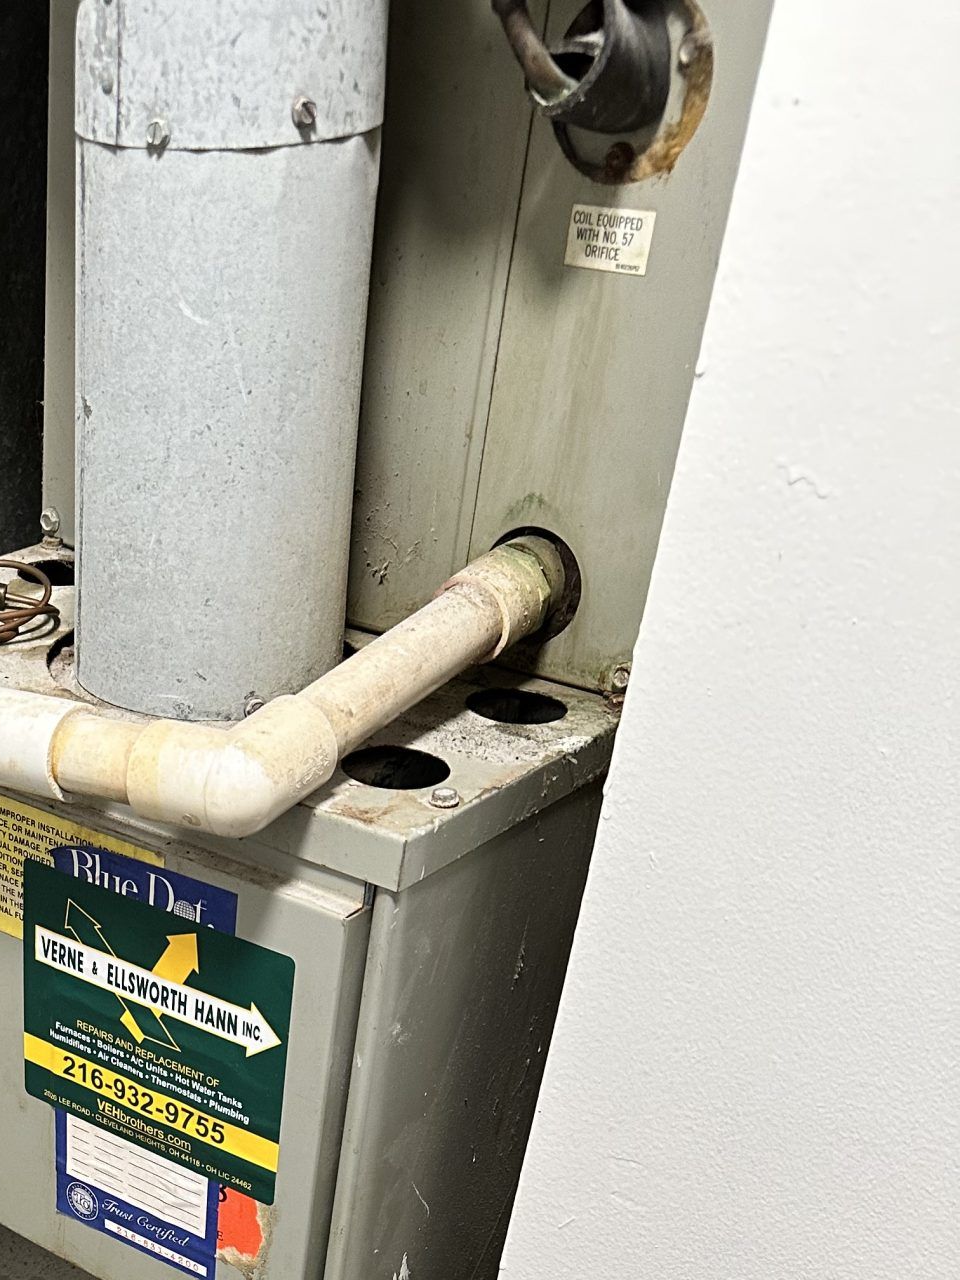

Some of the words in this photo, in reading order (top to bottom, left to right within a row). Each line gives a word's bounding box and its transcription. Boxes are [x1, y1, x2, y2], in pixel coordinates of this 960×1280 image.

[573, 210, 594, 226] COIL
[596, 213, 643, 232] EQUIPPED
[576, 226, 600, 242] WITH
[602, 230, 618, 245] NO.
[621, 232, 635, 247] 57
[584, 244, 621, 261] ORIFICE
[11, 823, 23, 834] OR
[0, 894, 8, 904] IN
[9, 898, 24, 911] THE
[1, 884, 16, 897] THE
[40, 935, 85, 974] VERNE
[91, 960, 99, 976] &
[106, 962, 188, 1017] ELLSWORTH
[194, 997, 239, 1038] HANN
[241, 1020, 263, 1043] INC.
[49, 1028, 92, 1054] Humidifiers
[97, 1050, 110, 1062] Air
[110, 1056, 144, 1079] Cleaners
[150, 1074, 202, 1104] Thermostats
[208, 1099, 250, 1126] Plumbing
[55, 1021, 91, 1043] Furnaces
[96, 1039, 125, 1058] Boilers
[130, 1055, 144, 1068] A/C
[145, 1061, 168, 1078] Units
[174, 1073, 190, 1087] Hot
[191, 1079, 216, 1098] Water
[217, 1091, 243, 1109] Tanks
[76, 1019, 114, 1043] REPAIRS
[114, 1037, 134, 1052] AND
[134, 1045, 205, 1082] REPLACEMENT
[205, 1076, 220, 1088] OF
[62, 1055, 226, 1145] 216-932-9755
[96, 1097, 192, 1151] VEHbrothers.com
[58, 1096, 72, 1107] LEE
[71, 1102, 91, 1117] ROAD
[95, 1113, 134, 1137] CLEVELAND
[168, 1147, 180, 1159] OH
[180, 1152, 201, 1168] 44118
[205, 1164, 218, 1176] OH
[217, 1170, 230, 1181] LIC
[101, 1198, 135, 1222] Trust
[136, 1215, 191, 1247] Certified
